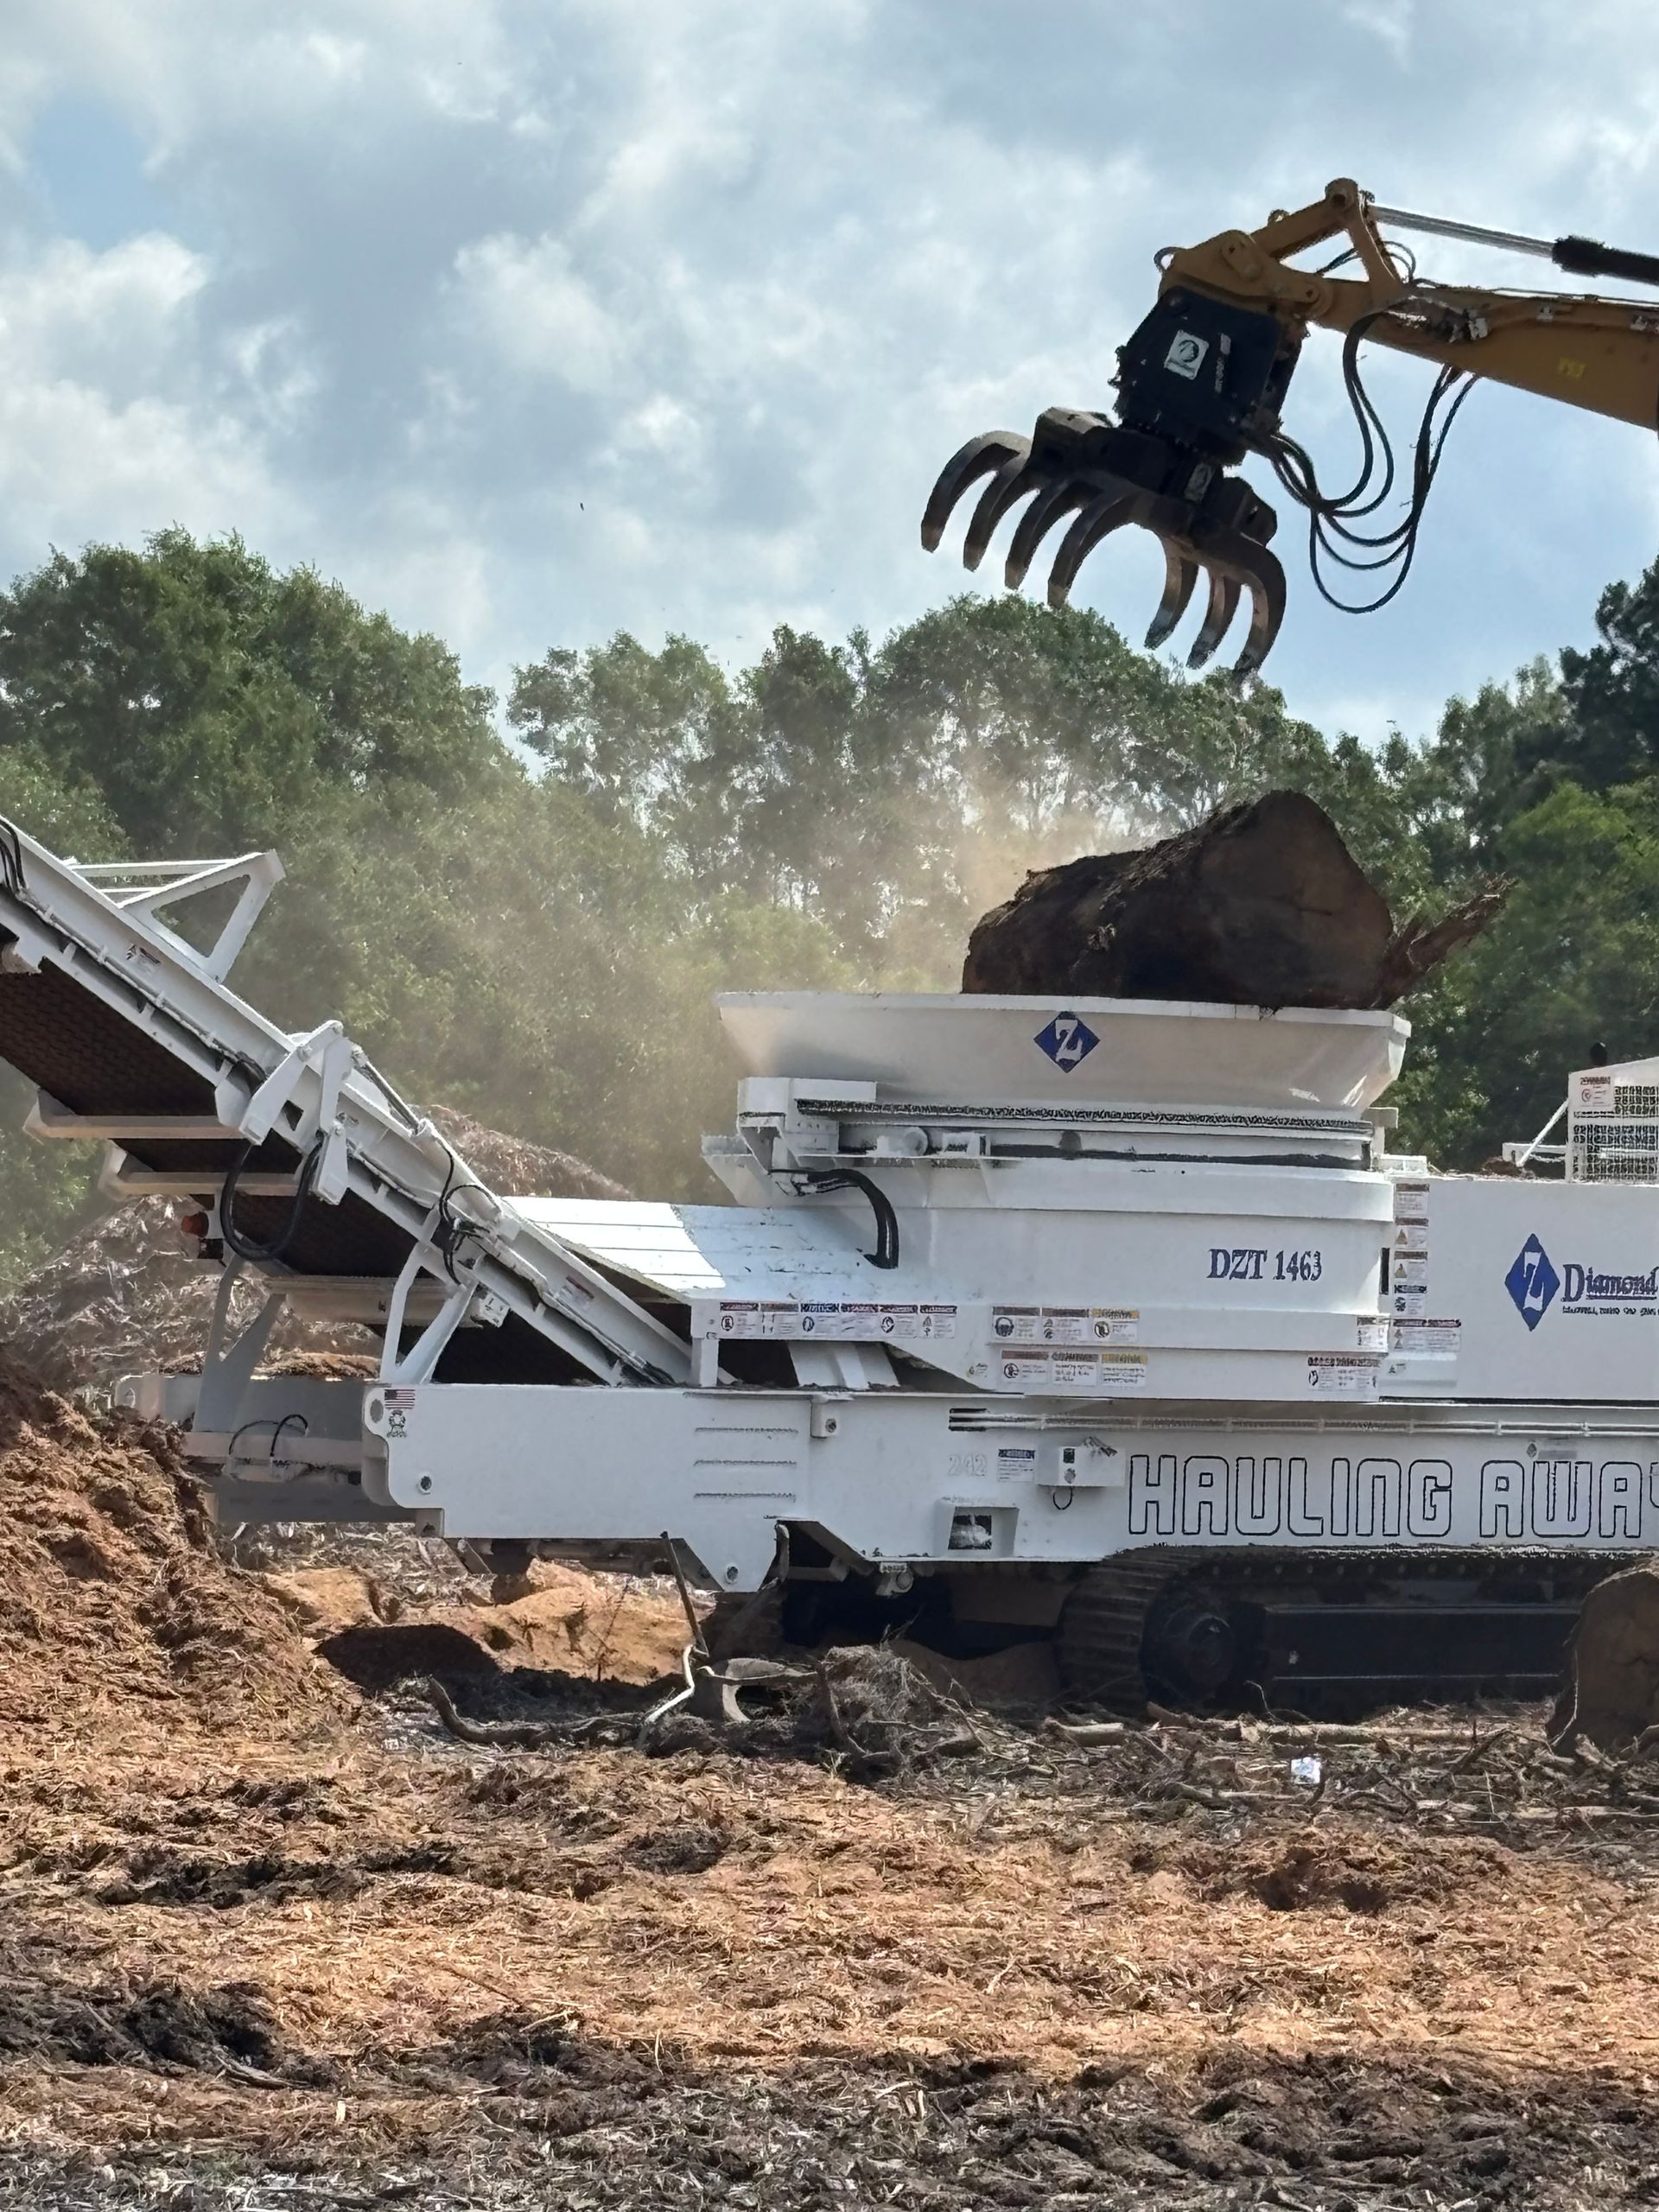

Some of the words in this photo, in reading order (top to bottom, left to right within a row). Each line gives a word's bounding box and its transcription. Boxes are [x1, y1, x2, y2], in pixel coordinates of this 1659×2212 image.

[1206, 1249, 1268, 1280] DZT
[1274, 1250, 1322, 1281] 1463
[1560, 1264, 1659, 1302] Diamond
[1128, 1455, 1453, 1537] HAULING
[1480, 1460, 1659, 1538] AWA
